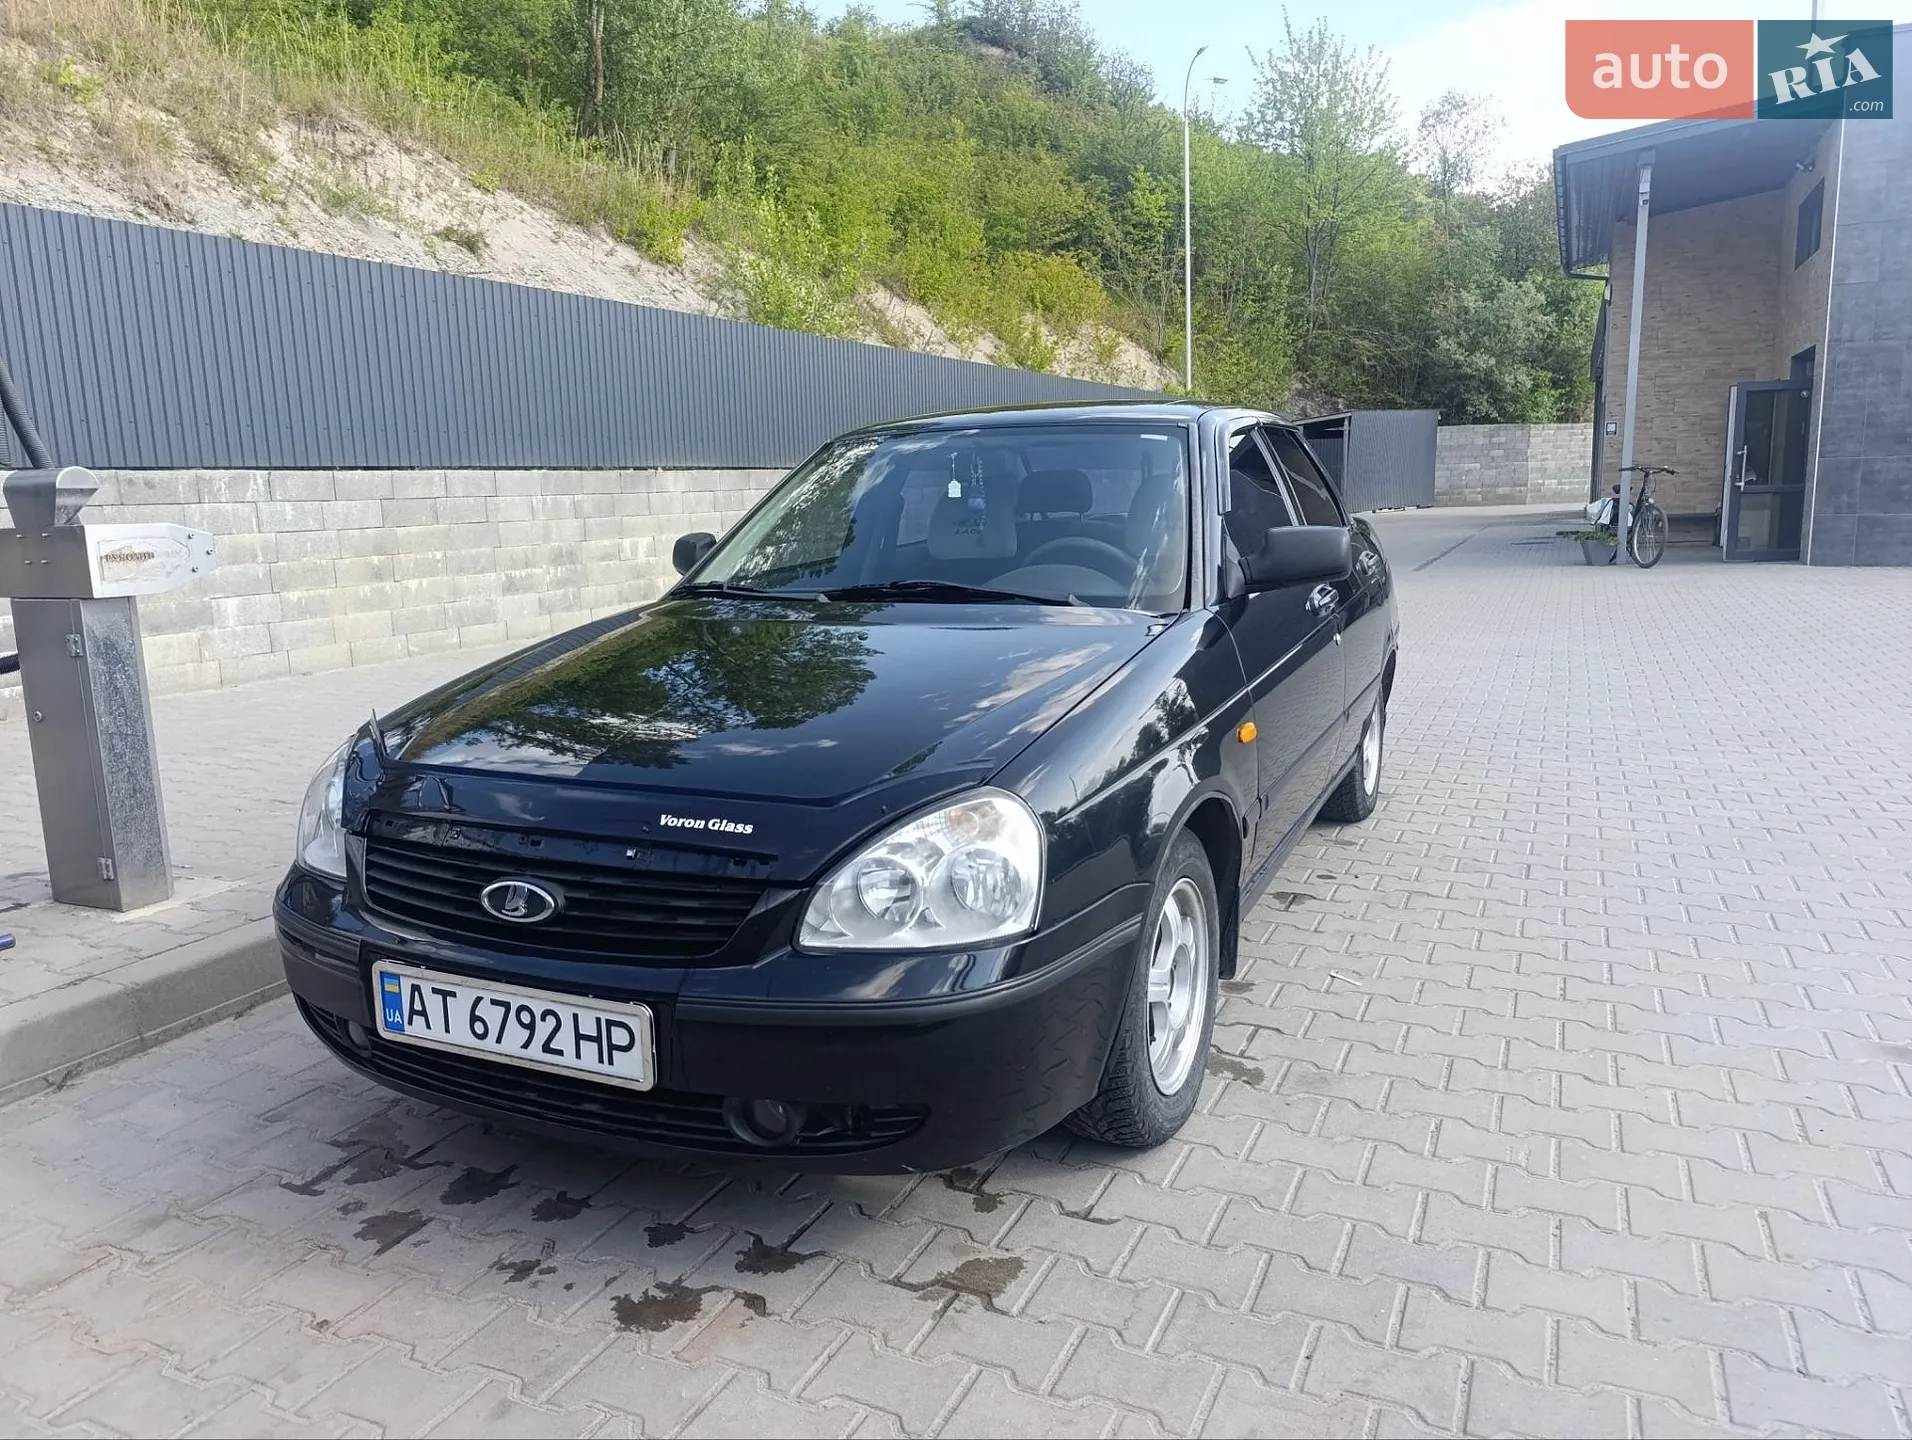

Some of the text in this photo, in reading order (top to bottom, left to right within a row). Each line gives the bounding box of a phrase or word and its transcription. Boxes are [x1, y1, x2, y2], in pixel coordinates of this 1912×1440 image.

[660, 814, 754, 834] Voron Glass
[386, 1009, 403, 1024] UA
[407, 983, 636, 1066] AT 6792 HP
